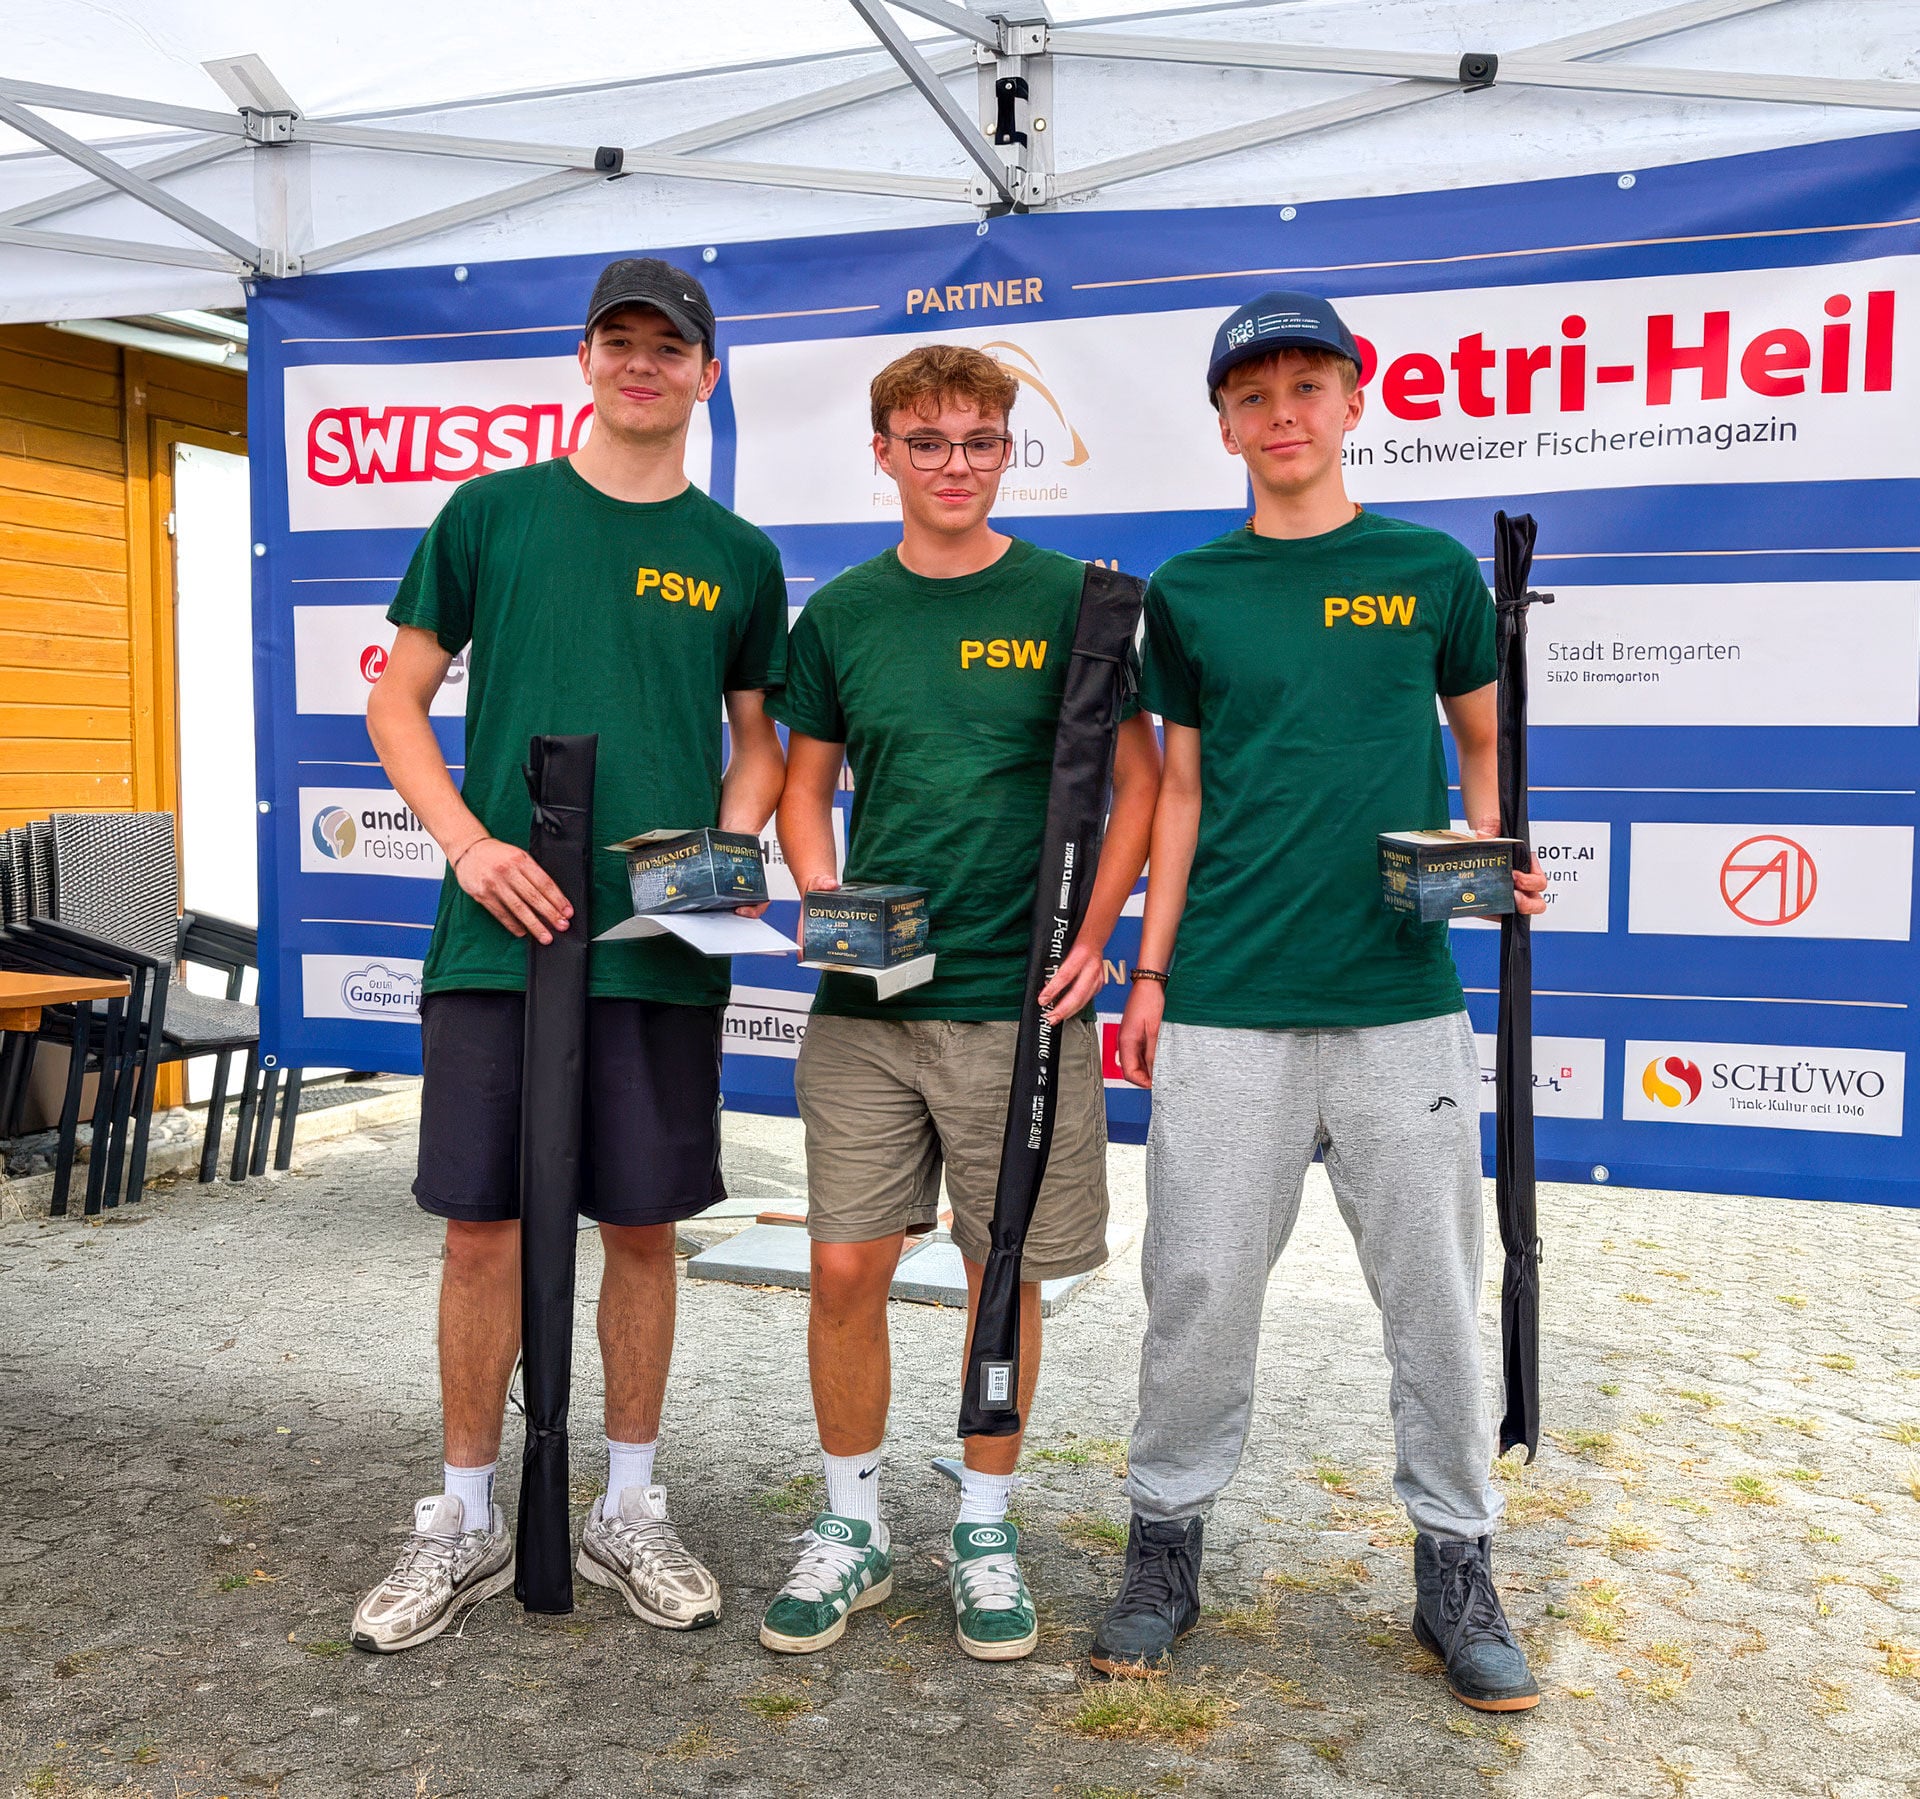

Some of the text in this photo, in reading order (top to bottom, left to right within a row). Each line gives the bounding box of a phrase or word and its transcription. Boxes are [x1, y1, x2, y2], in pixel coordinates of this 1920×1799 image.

[906, 277, 1043, 314] PARTNER
[1383, 436, 1527, 465] Schweizer
[1536, 416, 1798, 457] Fischereimagazin
[635, 567, 721, 611] PSW
[1324, 594, 1417, 628] PSW
[960, 638, 1047, 671] PSW
[1547, 641, 1741, 665] Stadt Bremgarten
[364, 834, 434, 862] reisen
[1712, 1062, 1885, 1099] SCHÜWO
